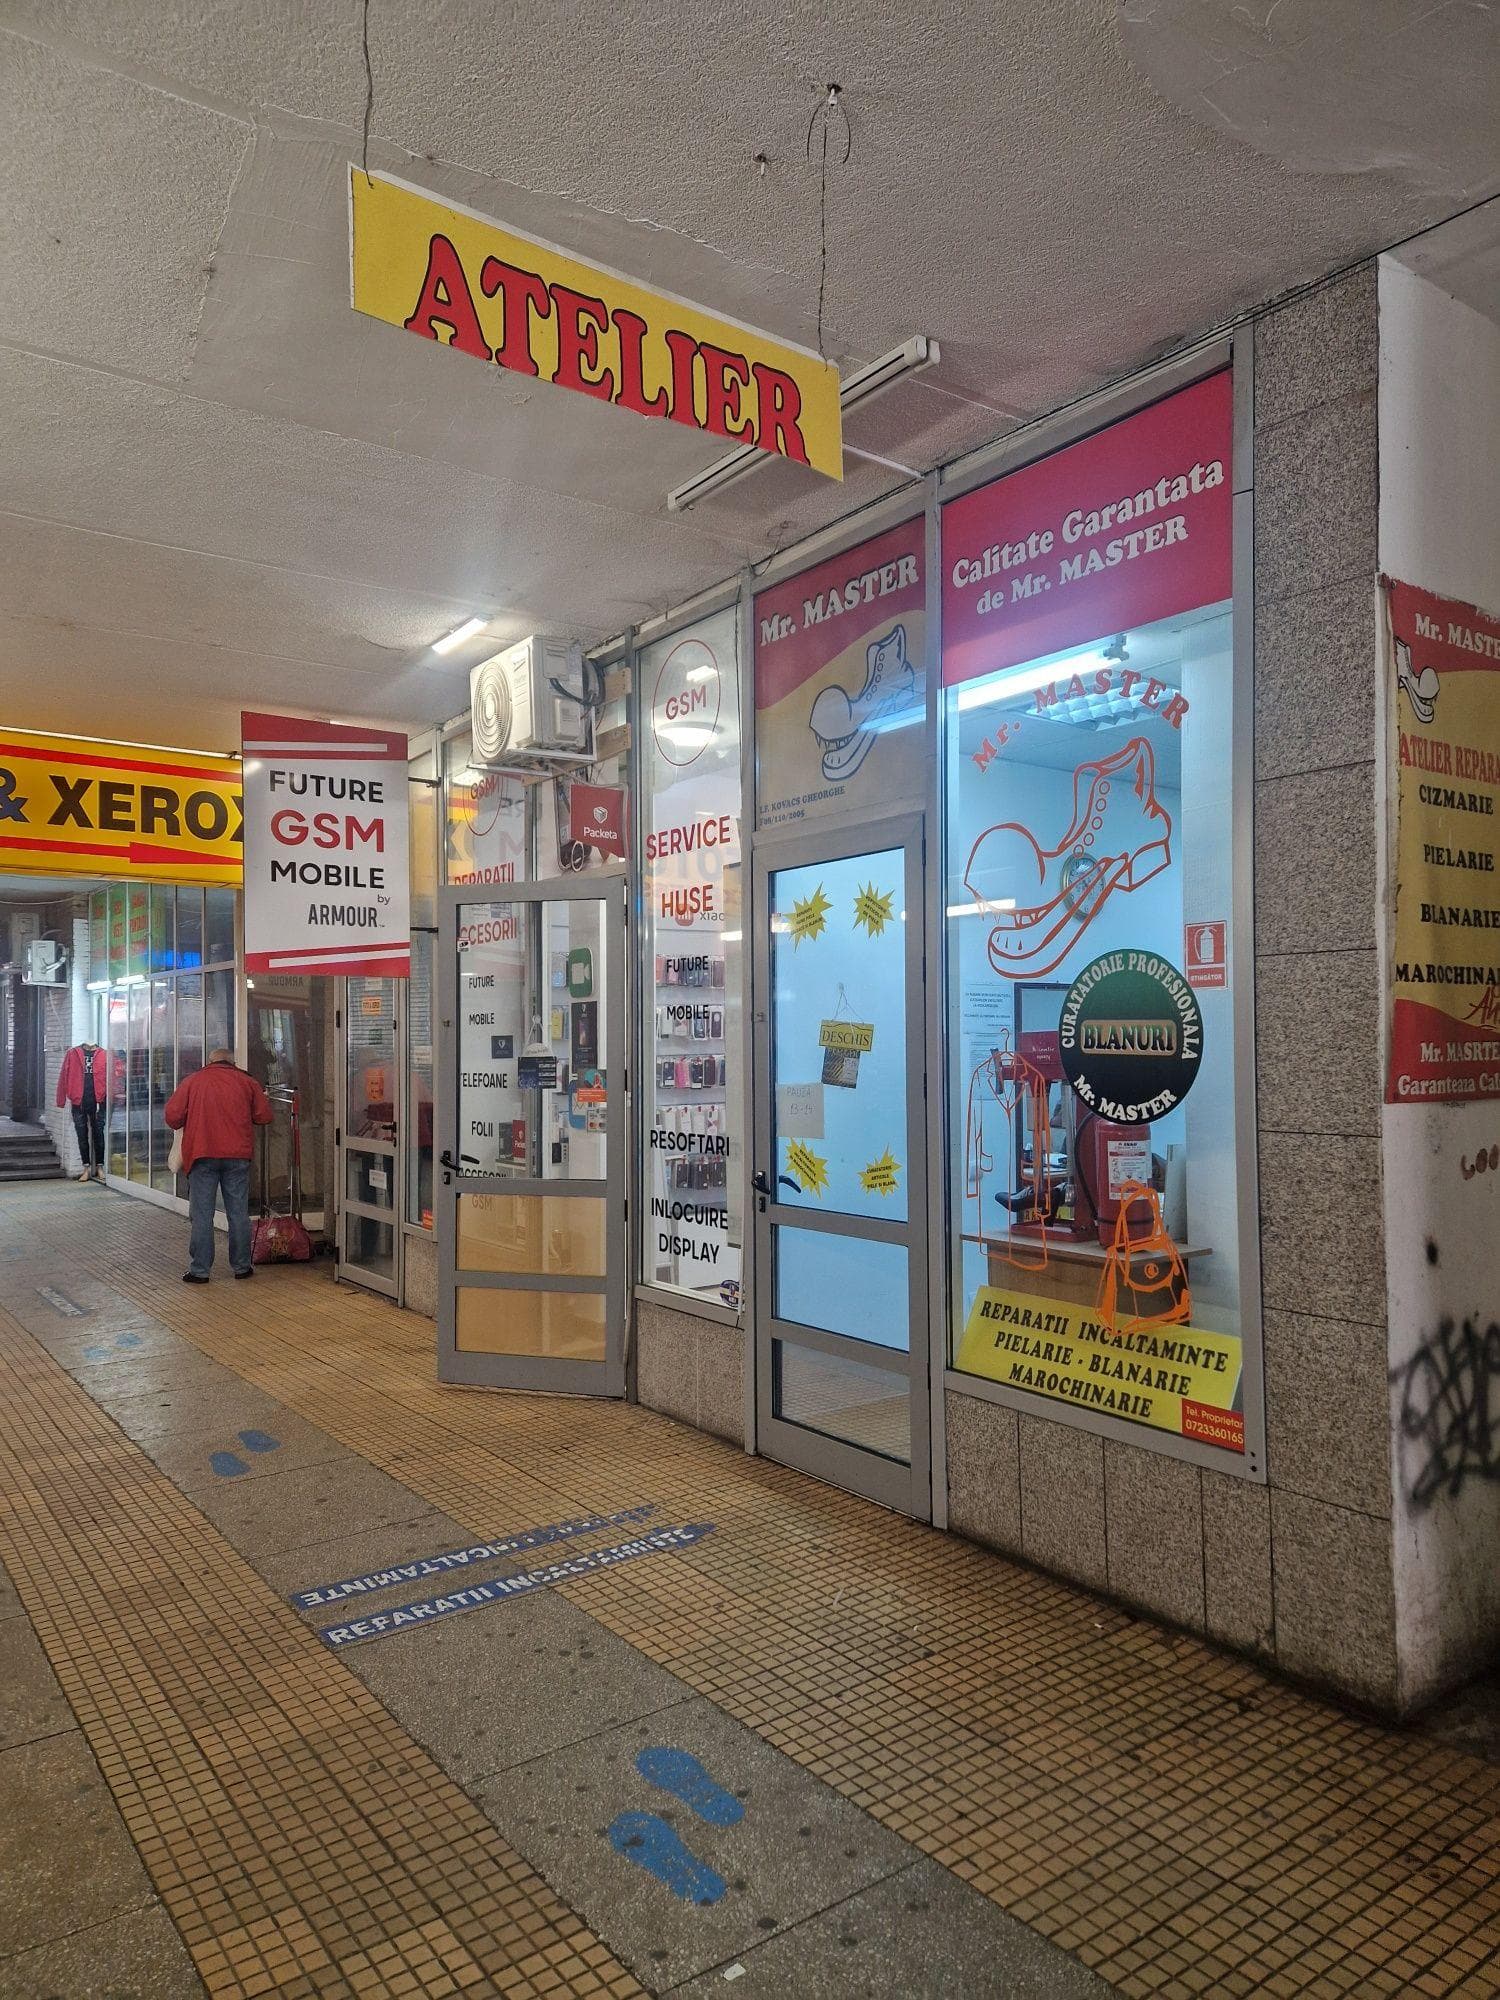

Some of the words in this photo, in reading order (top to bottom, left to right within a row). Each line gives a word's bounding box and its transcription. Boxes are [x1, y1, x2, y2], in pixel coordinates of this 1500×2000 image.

[403, 233, 811, 468] ATELIER
[952, 529, 1054, 588] Calitate
[1062, 459, 1225, 544] Garantata
[976, 590, 1005, 615] de
[1011, 572, 1051, 603] Mr.
[1059, 515, 1189, 585] MASTER
[760, 612, 796, 647] Mr.
[802, 554, 919, 630] MASTER
[1414, 613, 1442, 642] Mr.
[665, 685, 707, 720] GSM
[971, 721, 1021, 773] Mr.
[1033, 668, 1190, 730] MASTER
[1400, 732, 1453, 777] ATELIER
[0, 768, 30, 824] &
[269, 769, 384, 804] FUTURE
[802, 785, 846, 804] GHEORGHE
[1419, 784, 1494, 815] CIZMARIE
[270, 808, 385, 853] GSM
[583, 826, 618, 840] Packeta
[645, 815, 731, 861] SERVICE
[1423, 844, 1495, 872] PIELARIE
[270, 860, 385, 890] MOBILE
[377, 893, 391, 906] by
[661, 884, 714, 918] HUSE
[308, 903, 378, 928] ARMOUR
[1420, 903, 1500, 928] BLANARIE
[666, 955, 709, 973] FUTURE
[469, 975, 495, 988] FUTURE
[469, 1012, 495, 1026] MOBILE
[666, 1004, 710, 1020] MOBILE
[1061, 952, 1124, 1049] CURATATORIE
[1128, 952, 1200, 1060] PROFESIONALA
[822, 1030, 870, 1047] DESCHIS
[1082, 1023, 1175, 1052] BLANURI
[1420, 1042, 1444, 1062] Mr.
[460, 1072, 508, 1089] ELEFOANE
[1398, 1073, 1476, 1096] Garanteaza
[1073, 1074, 1096, 1106] Mr.
[1098, 1088, 1178, 1122] MASTER
[471, 1121, 494, 1137] FOLII
[650, 1129, 730, 1156] RESOFTARI
[651, 1197, 729, 1230] INLOCUIRE
[659, 1233, 720, 1264] DISPLAY
[980, 1300, 1070, 1336] REPARATII
[1078, 1320, 1230, 1373] INCALTAMINTE
[994, 1330, 1074, 1366] PIELARIE
[1088, 1353, 1192, 1396] BLANARIE
[1008, 1362, 1154, 1418] MAROCHINARIE
[328, 1586, 495, 1645] REPARATII
